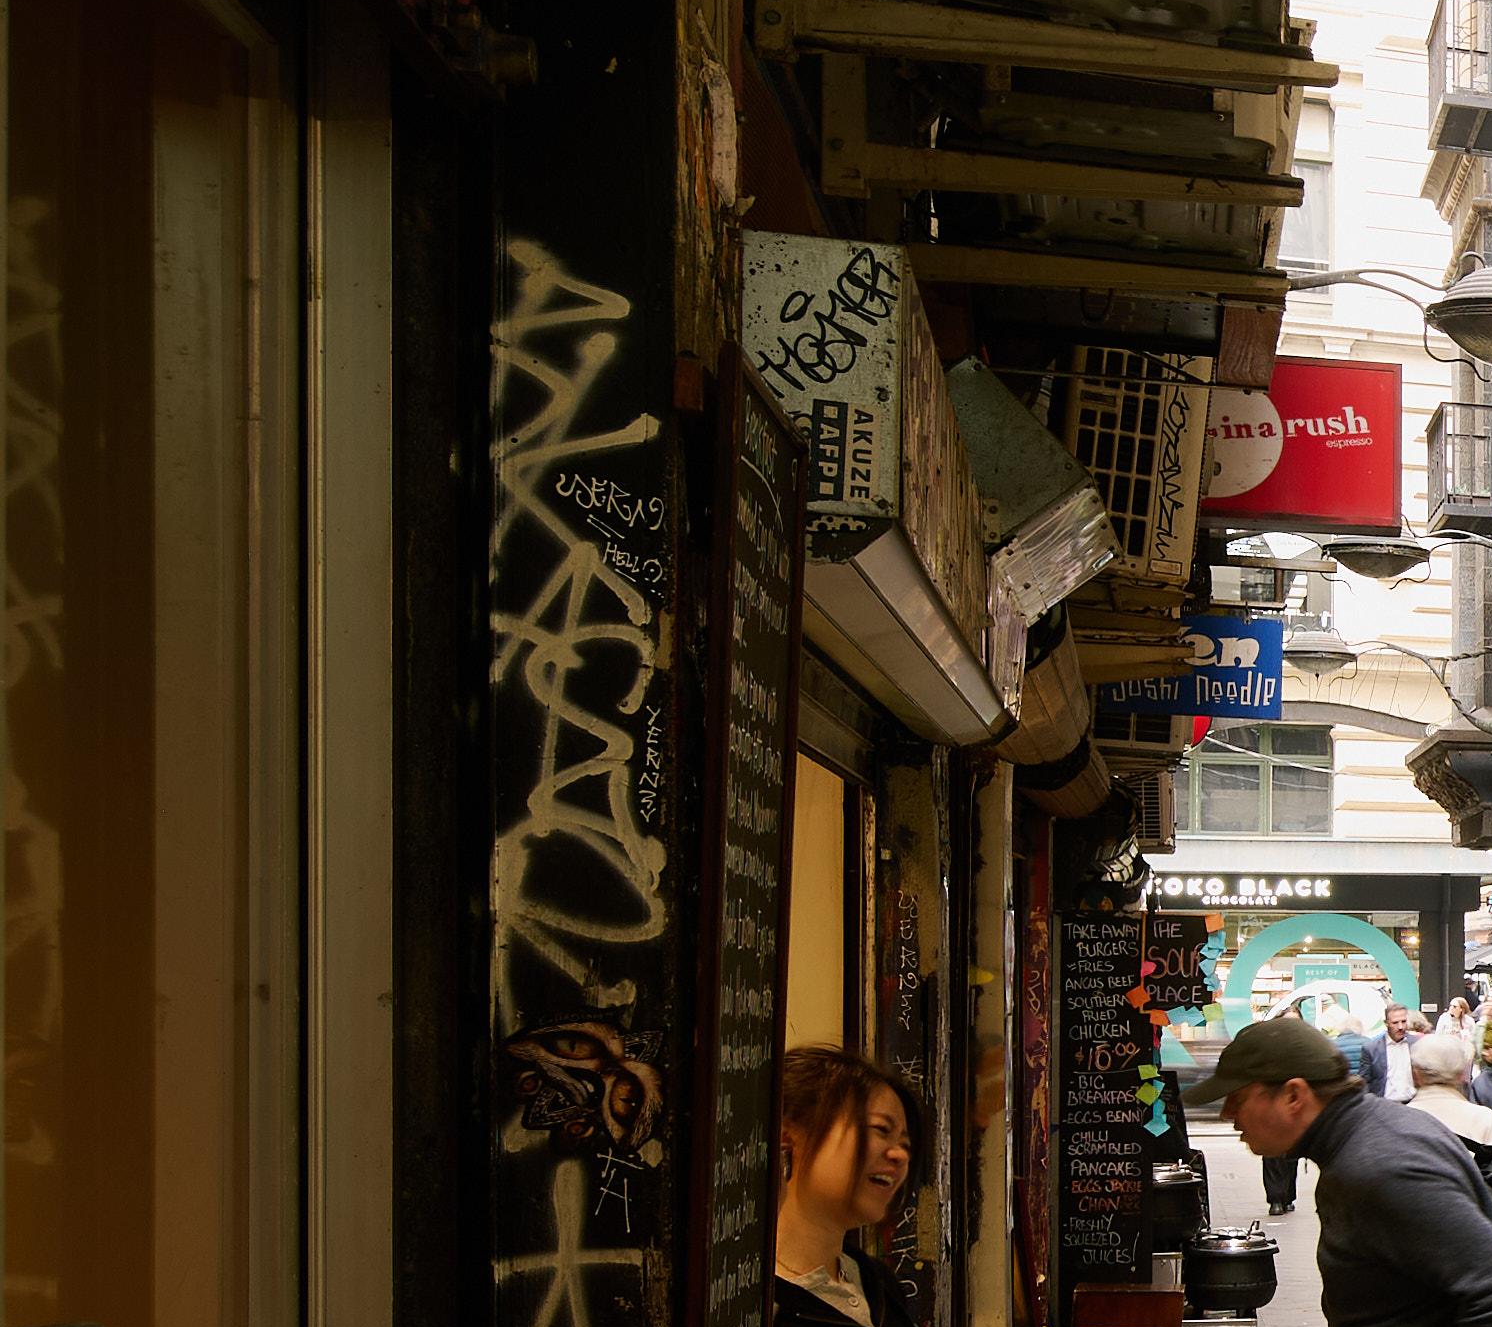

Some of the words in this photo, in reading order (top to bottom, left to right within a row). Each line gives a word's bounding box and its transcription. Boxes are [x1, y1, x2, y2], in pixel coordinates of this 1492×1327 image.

[1285, 407, 1369, 437] rush
[1326, 437, 1373, 448] espresso
[849, 408, 873, 499] AKUZE
[1239, 879, 1330, 896] BLACK
[1202, 896, 1278, 905] CHOCOLATE
[1154, 920, 1183, 938] THE
[1076, 941, 1139, 957] BURGERS
[1078, 960, 1114, 973] FRIES
[1065, 977, 1104, 991] ANGUS
[1108, 975, 1135, 988] BEEF
[1146, 984, 1203, 1003] PLACE
[1082, 1009, 1117, 1022] FRIED
[1069, 1020, 1130, 1040] CHICKEN
[1079, 1075, 1104, 1089] BIG
[1068, 1112, 1101, 1124] EGGS
[1068, 1143, 1141, 1155] SCRAMBLED
[1071, 1159, 1140, 1175] PANCAKES
[1071, 1180, 1100, 1193] EGGS
